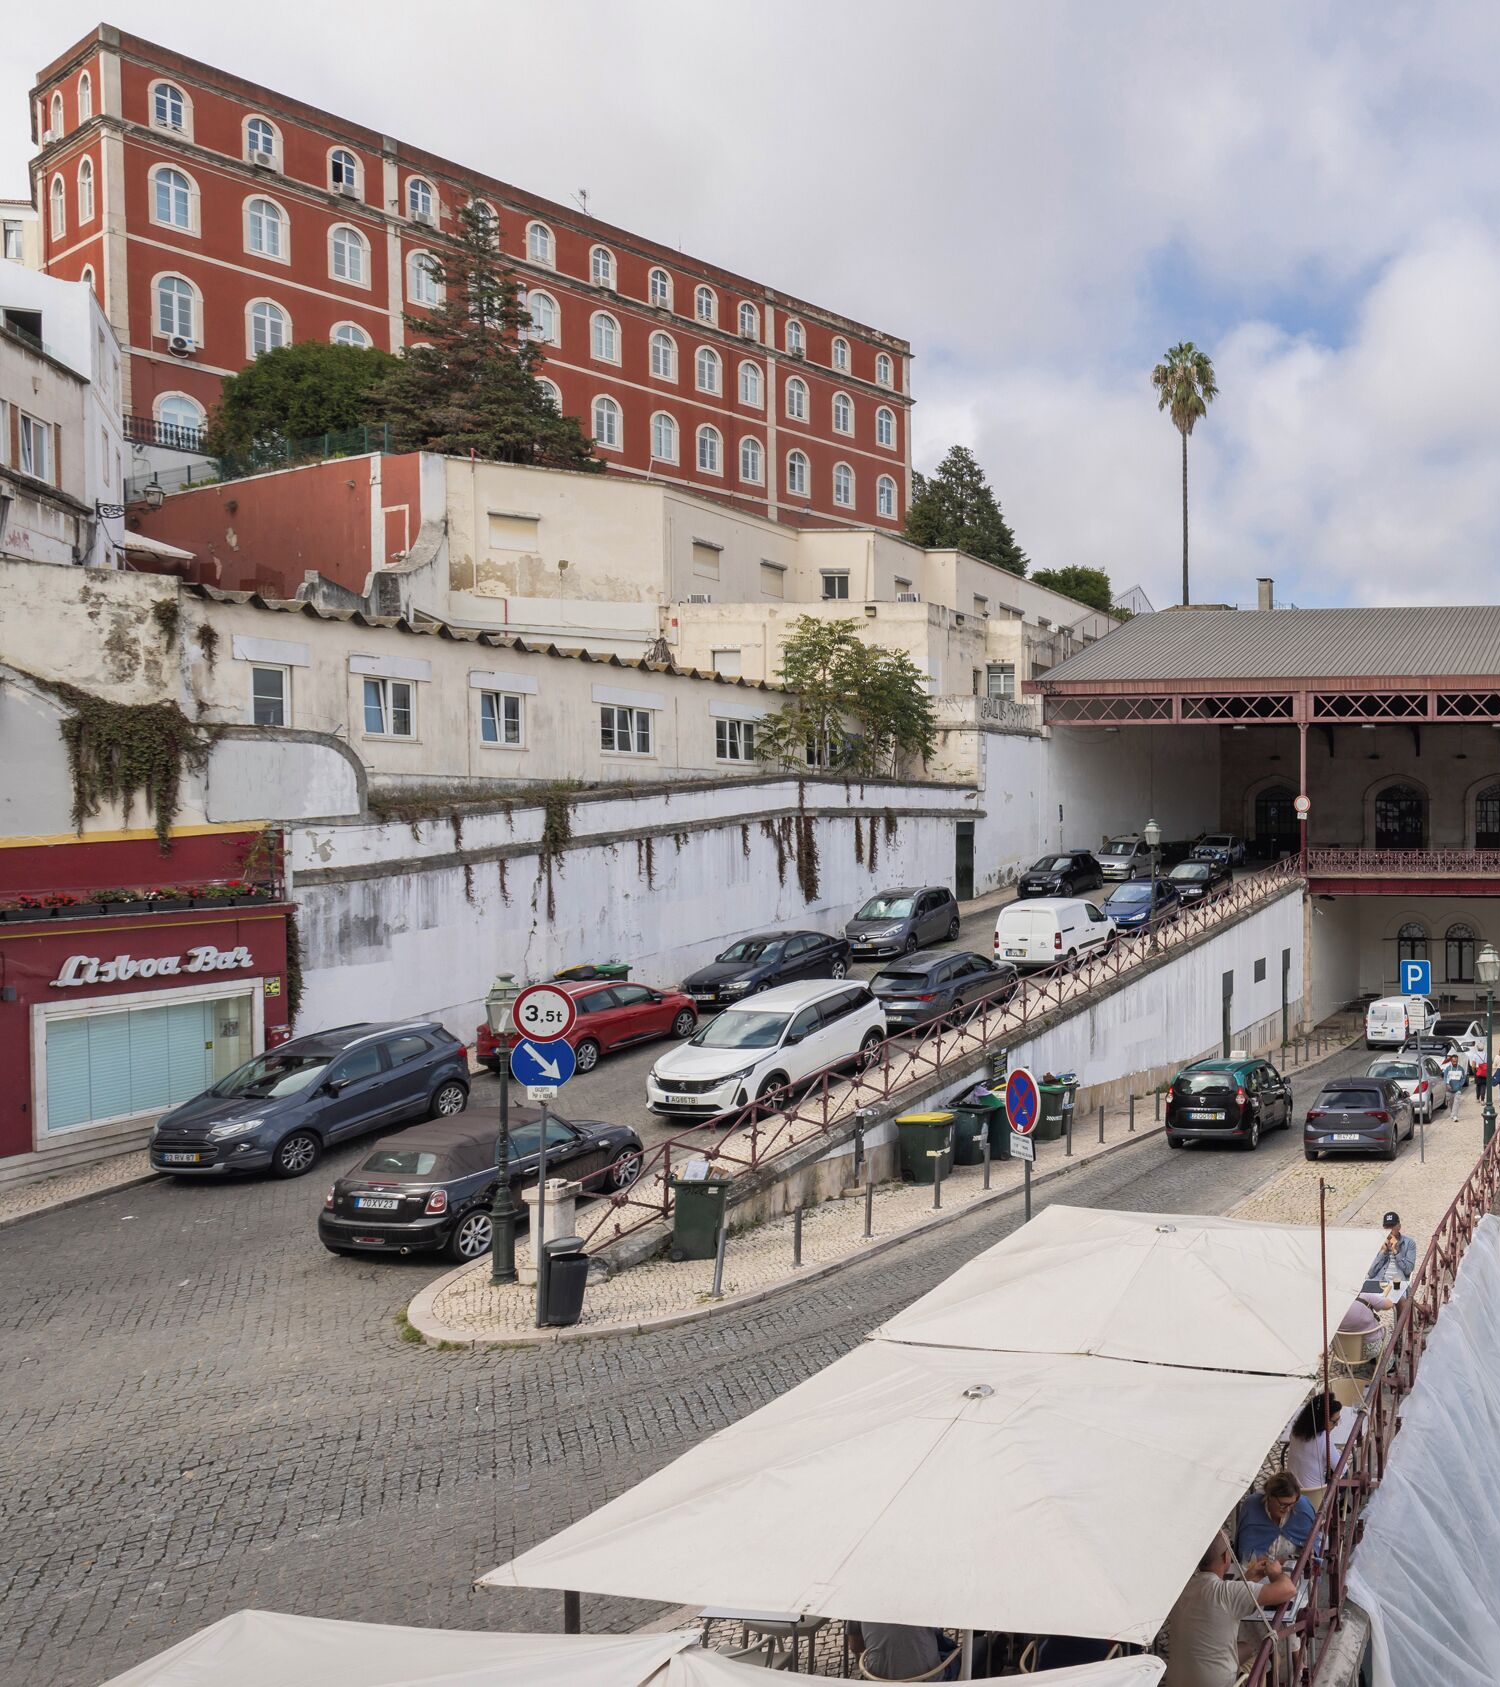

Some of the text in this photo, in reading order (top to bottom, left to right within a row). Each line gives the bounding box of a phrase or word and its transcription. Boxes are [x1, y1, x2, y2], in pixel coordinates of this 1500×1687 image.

[50, 946, 254, 987] Lisboa Bar
[1407, 964, 1423, 991] P
[525, 1004, 563, 1023] 3,5t
